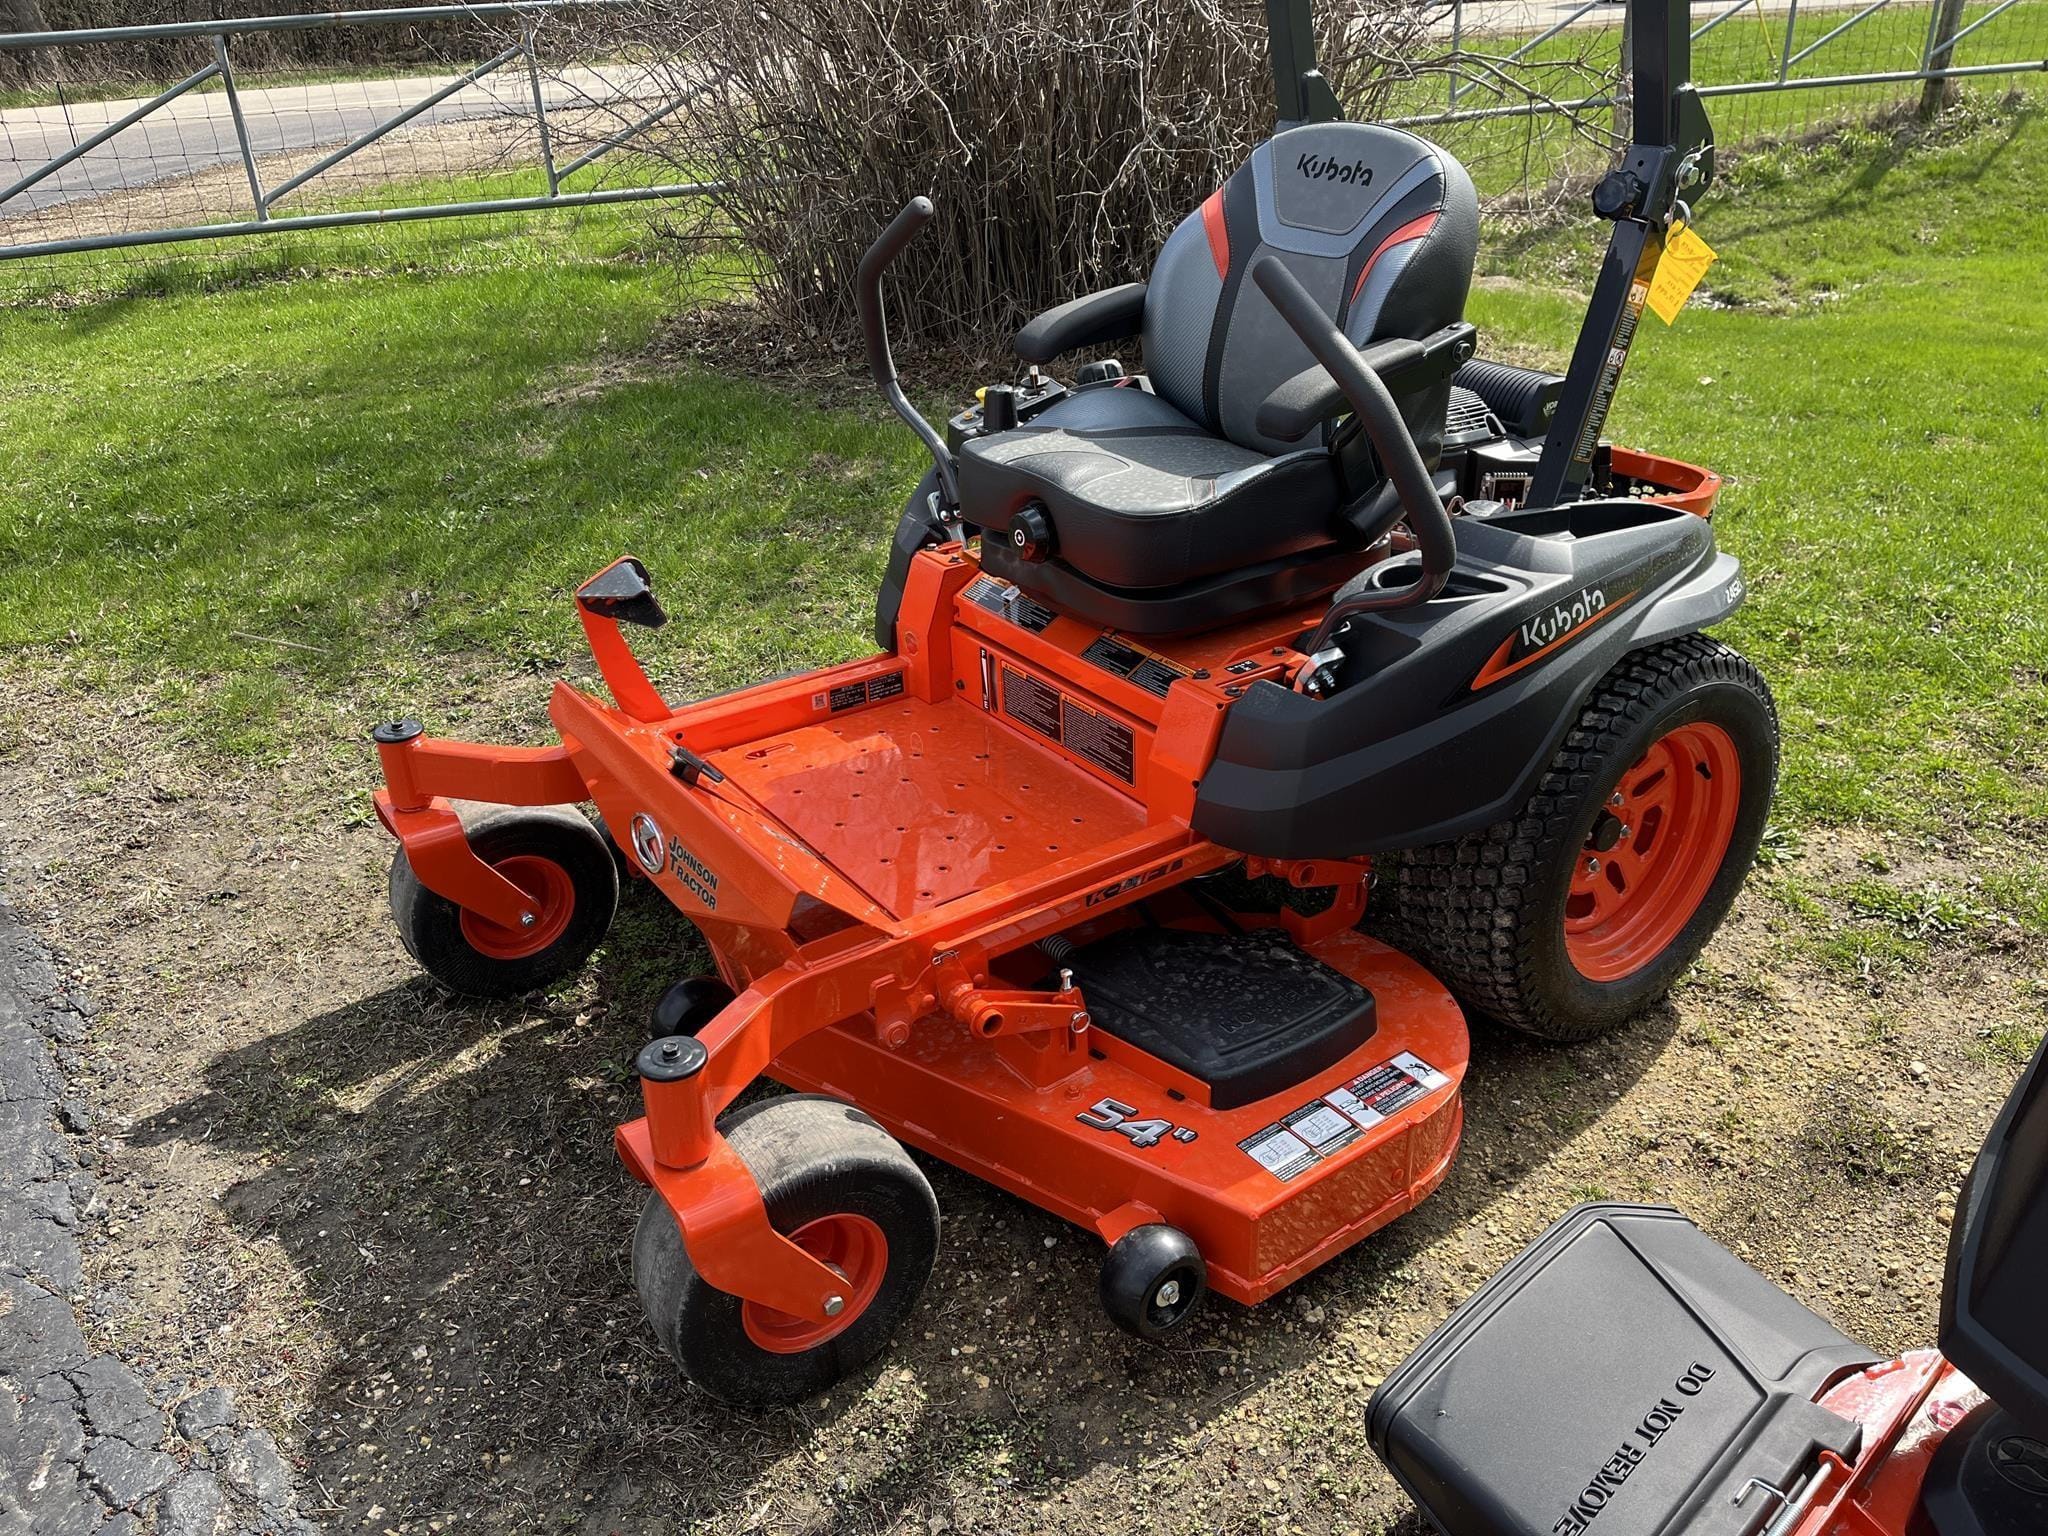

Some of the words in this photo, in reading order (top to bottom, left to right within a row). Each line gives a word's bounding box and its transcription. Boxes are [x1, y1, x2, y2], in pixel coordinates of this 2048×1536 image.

[1296, 153, 1373, 187] Kubota
[1521, 588, 1606, 647] Kubota
[668, 836, 718, 890] JOHNSON
[669, 852, 717, 910] TRACTOR
[1076, 1096, 1198, 1148] 54"
[1675, 1360, 1716, 1396] DO
[1635, 1398, 1685, 1448] NOT
[1552, 1441, 1647, 1536] REMOVE
